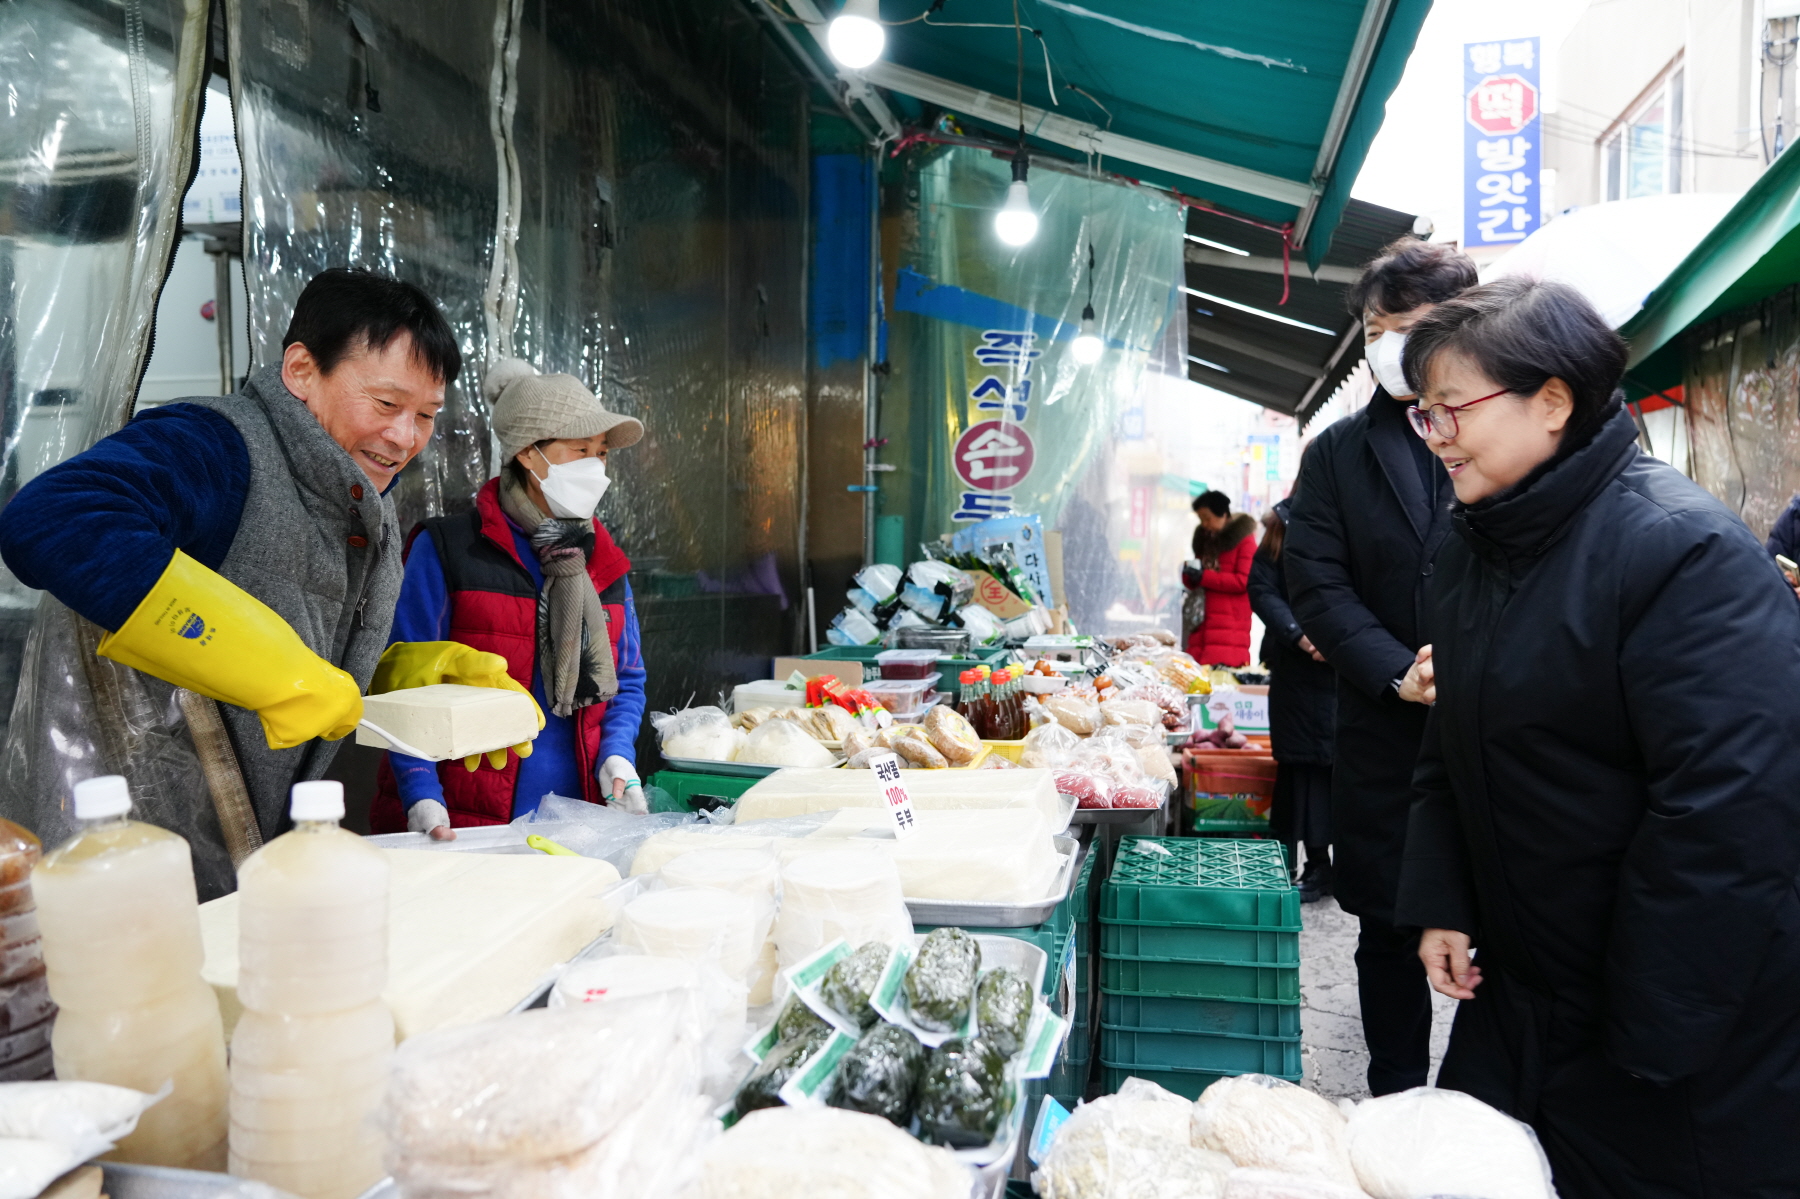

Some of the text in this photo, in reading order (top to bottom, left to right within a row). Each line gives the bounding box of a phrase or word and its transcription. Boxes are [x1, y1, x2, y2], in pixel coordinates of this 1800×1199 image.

[1469, 40, 1535, 73] 행복
[1478, 82, 1523, 127] 떡
[1476, 136, 1532, 241] 방앗간
[1234, 709, 1264, 721] 새송이
[886, 786, 908, 806] 100%
[896, 808, 914, 830] 두부
